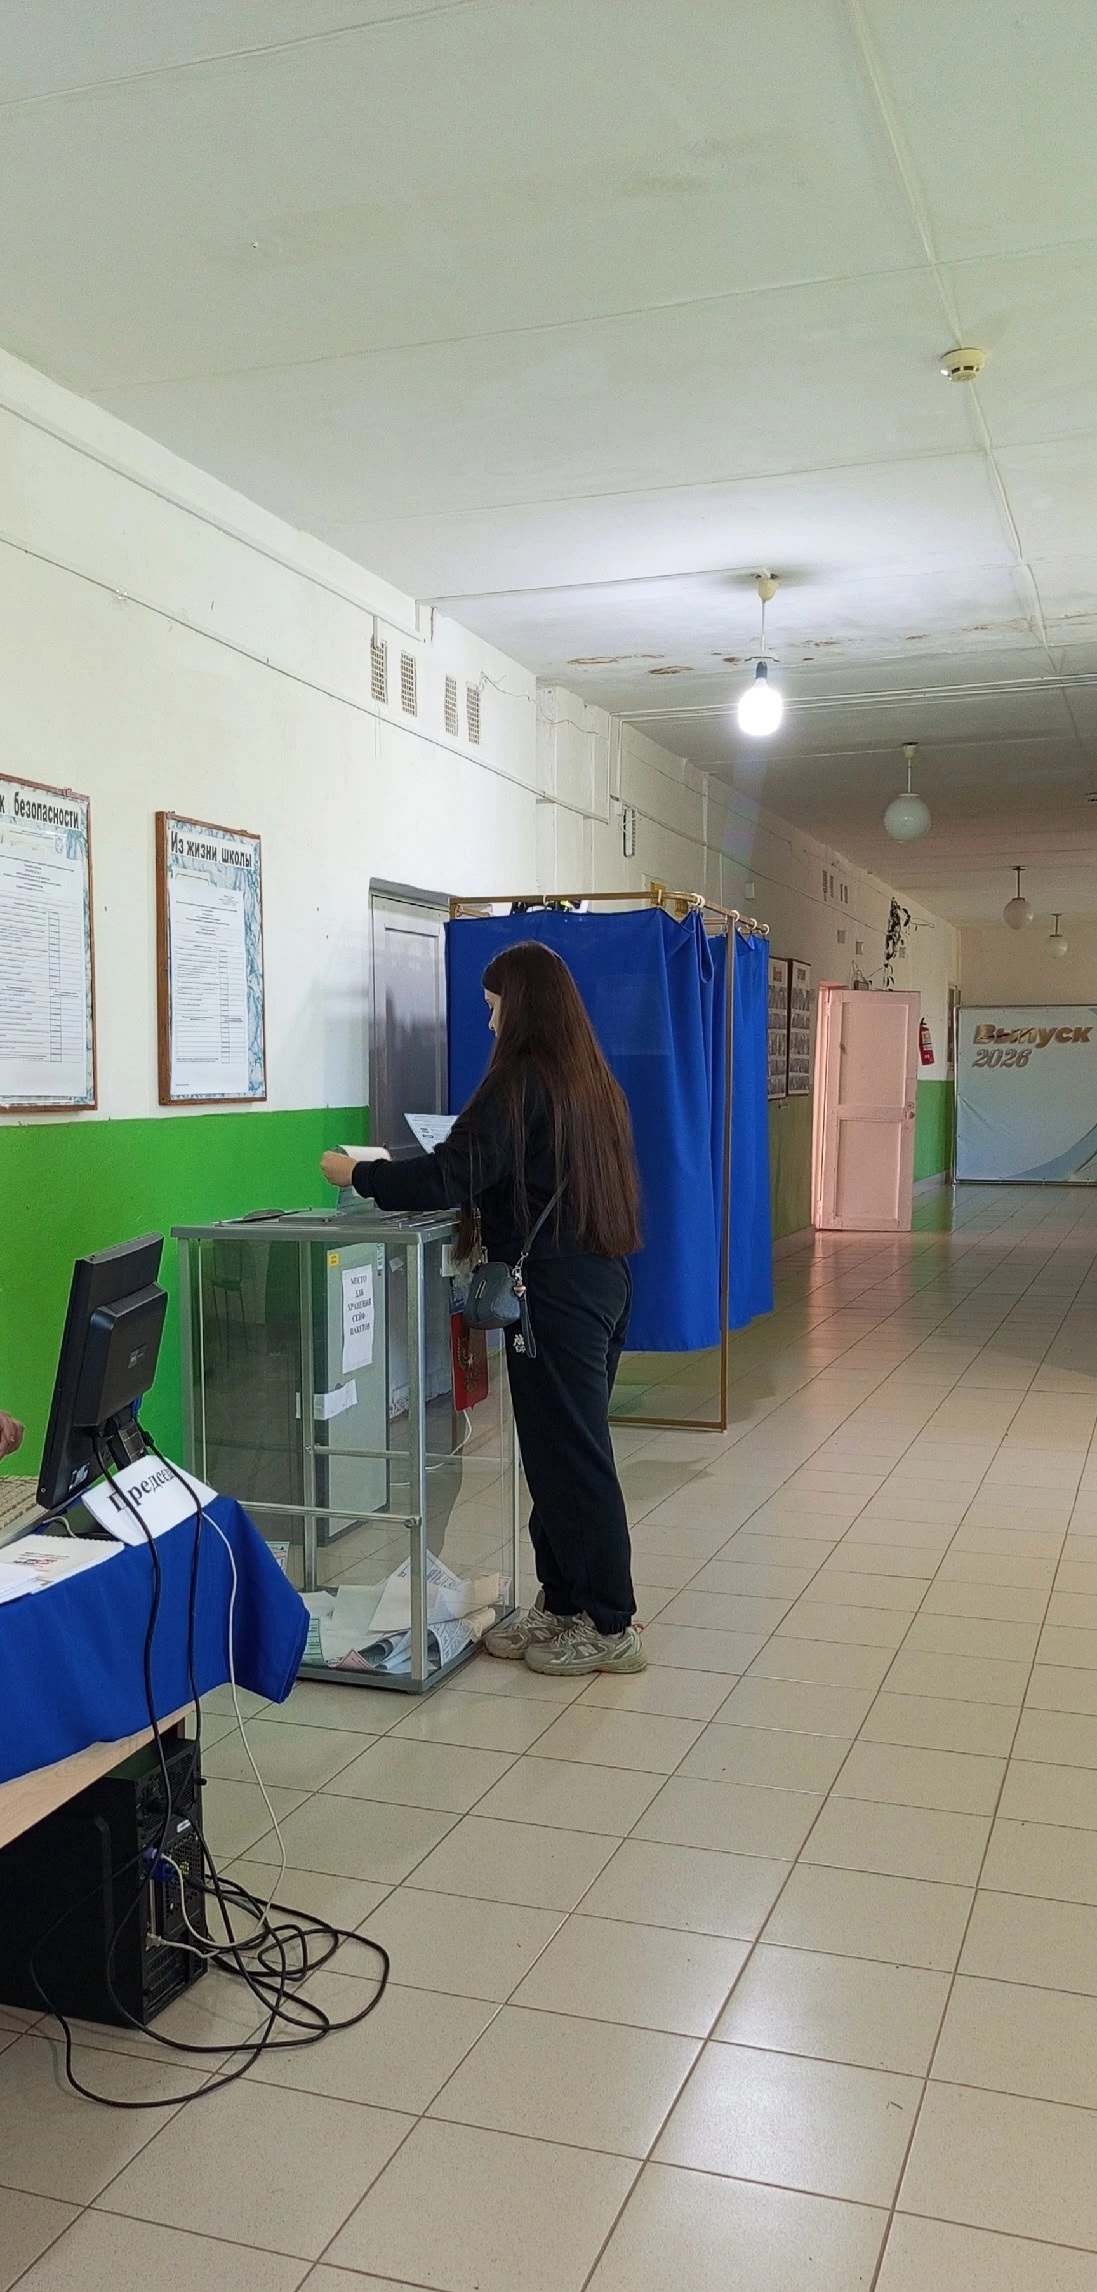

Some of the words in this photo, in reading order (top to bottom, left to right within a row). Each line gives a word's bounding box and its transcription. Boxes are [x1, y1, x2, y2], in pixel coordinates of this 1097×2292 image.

[14, 791, 79, 829] безопасности
[171, 831, 184, 854] Из
[186, 840, 217, 862] жизни
[221, 847, 252, 868] школы
[973, 1024, 1093, 1048] Выпуск
[972, 1048, 1032, 1068] 2026
